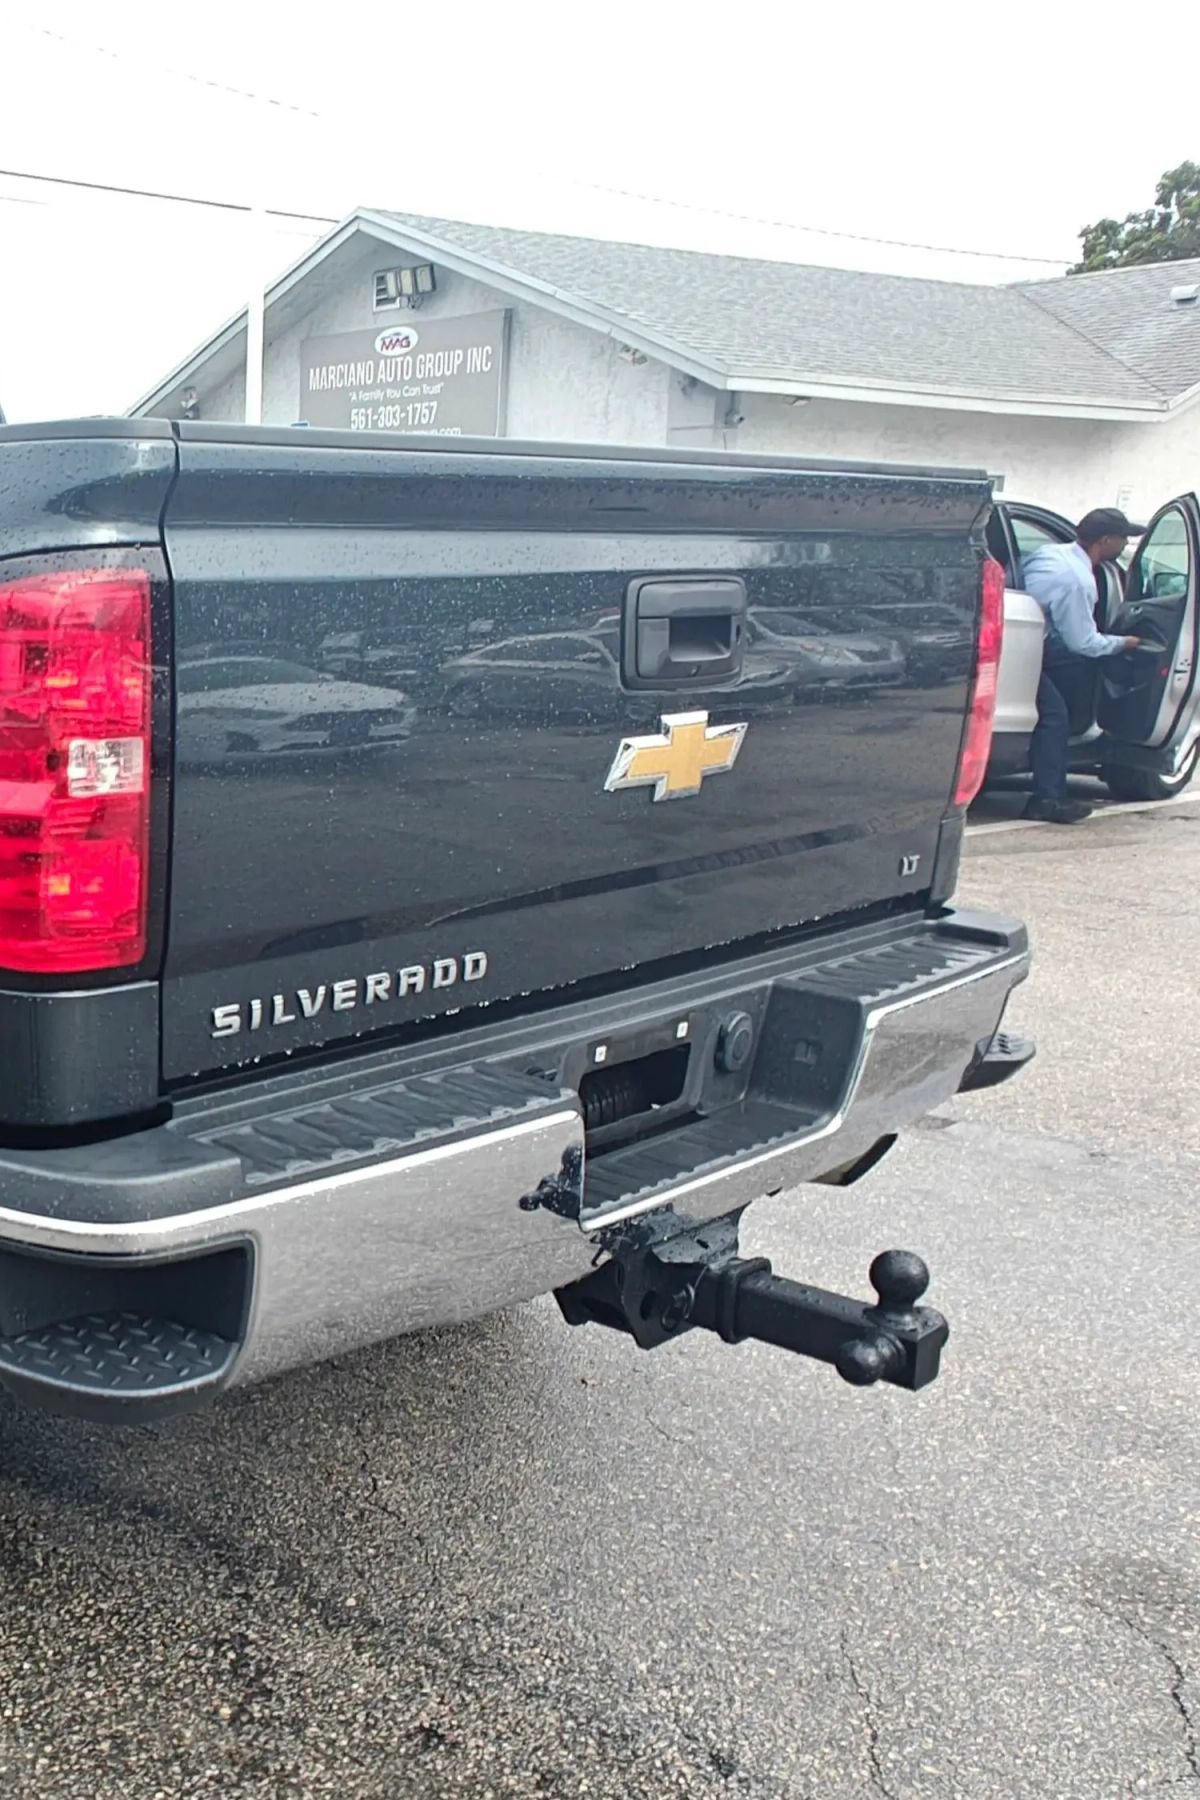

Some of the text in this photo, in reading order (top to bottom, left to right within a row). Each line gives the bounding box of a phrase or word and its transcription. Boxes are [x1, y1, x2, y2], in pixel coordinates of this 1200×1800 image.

[380, 334, 411, 351] MAG
[308, 345, 492, 391] MARCIANO AUTO GROUP INC
[358, 388, 385, 402] Family
[386, 387, 401, 399] You
[402, 384, 422, 397] Can
[350, 400, 438, 430] 561-303-1757
[901, 854, 921, 876] LT
[210, 951, 488, 1039] SILVERADO
